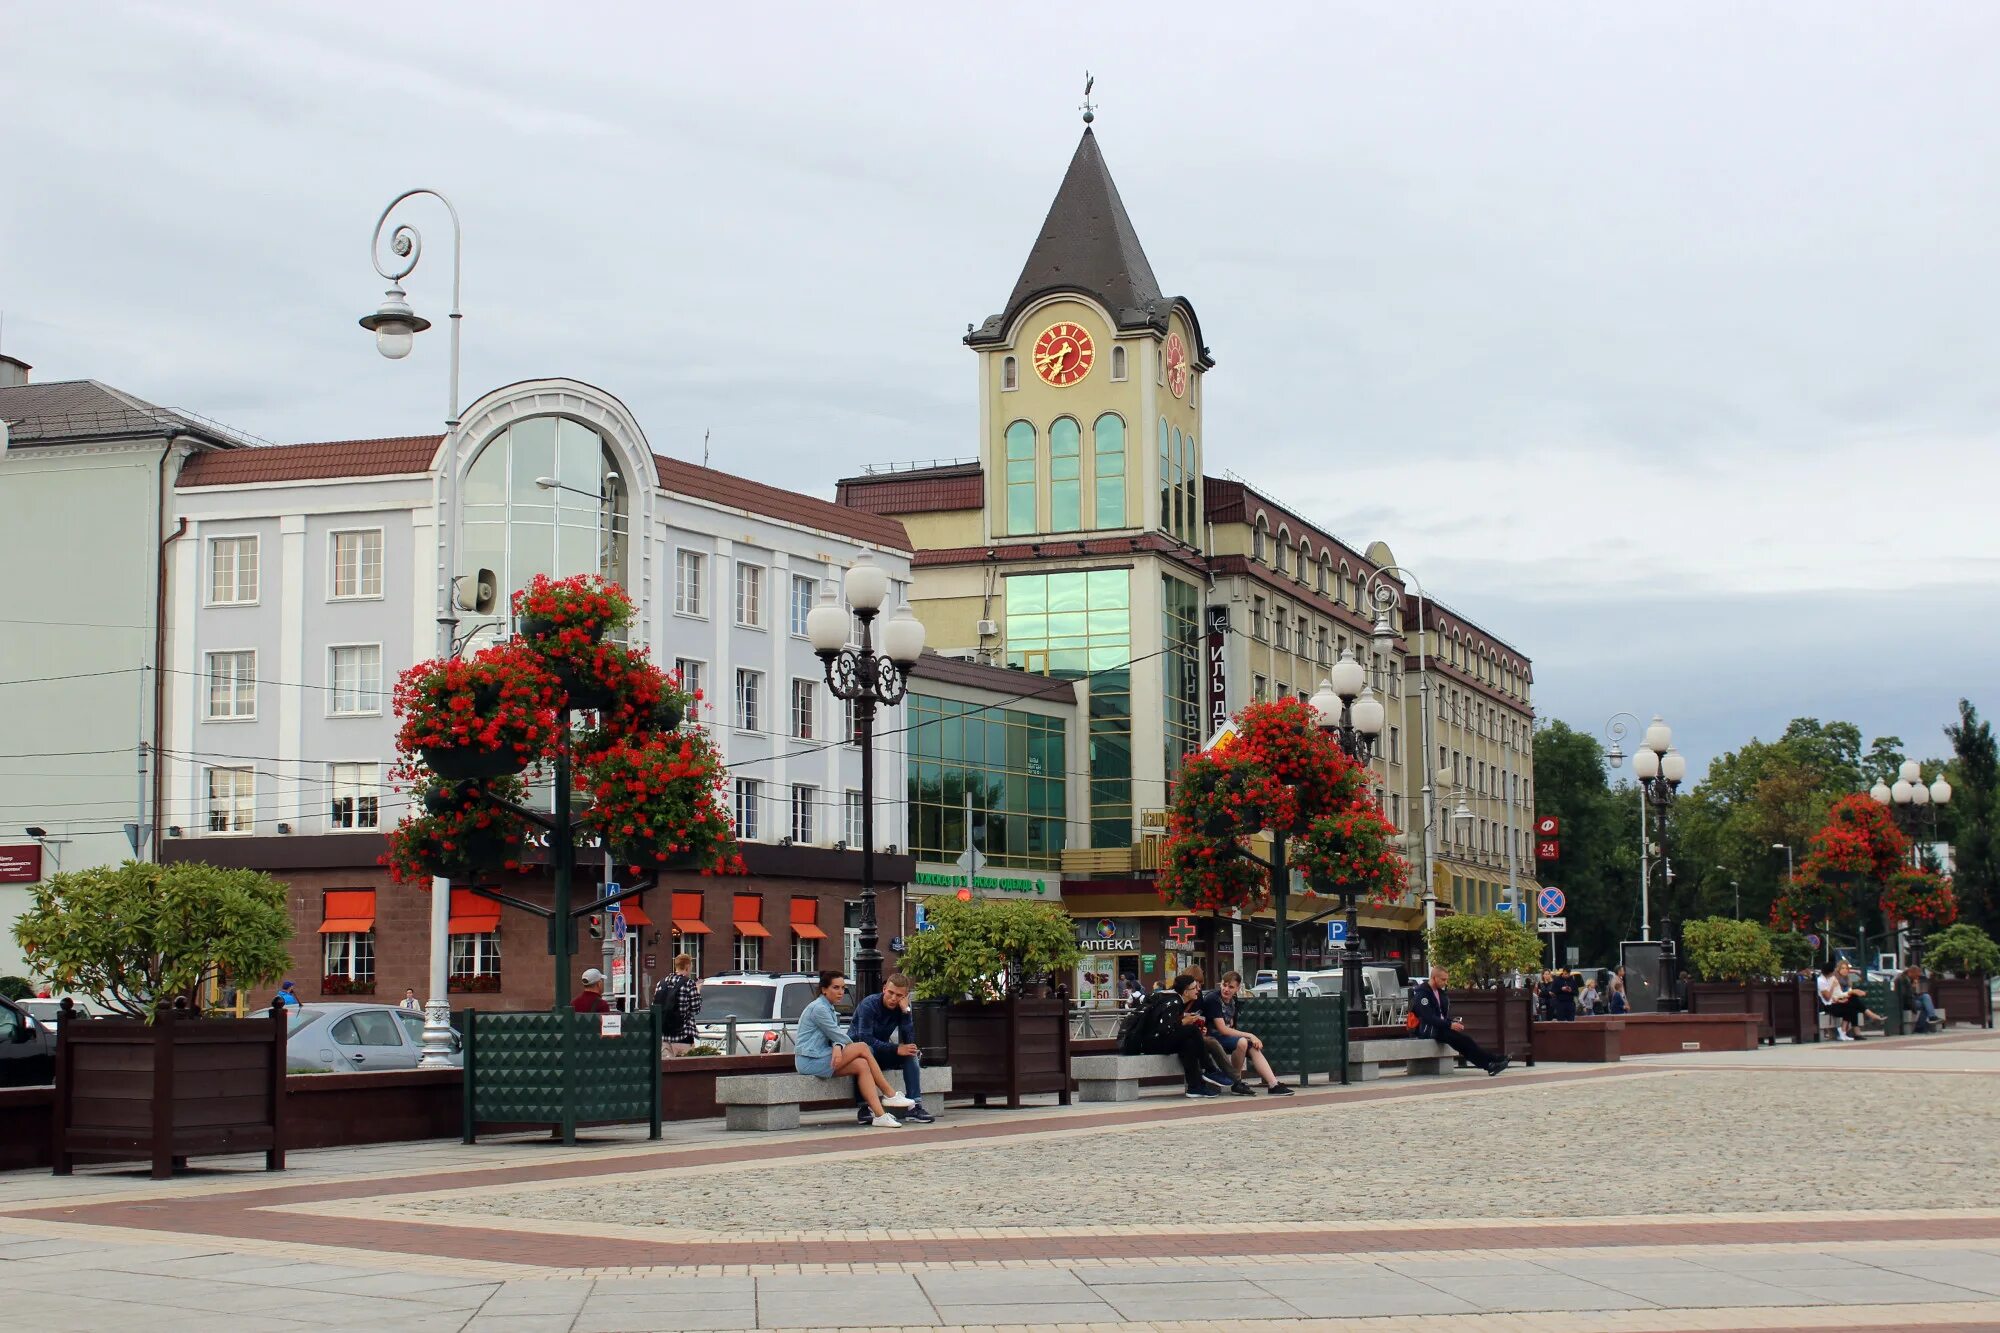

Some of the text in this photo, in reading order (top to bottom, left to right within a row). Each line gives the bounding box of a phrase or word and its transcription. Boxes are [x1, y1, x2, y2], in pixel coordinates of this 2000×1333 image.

[1211, 646, 1225, 693] ИЛЬ
[1542, 843, 1555, 853] 24
[961, 876, 998, 890] ЖНСКАЯ
[1000, 878, 1032, 893] ОДЕЖДА
[1332, 923, 1343, 939] P
[1081, 940, 1134, 951] АПТЕКА
